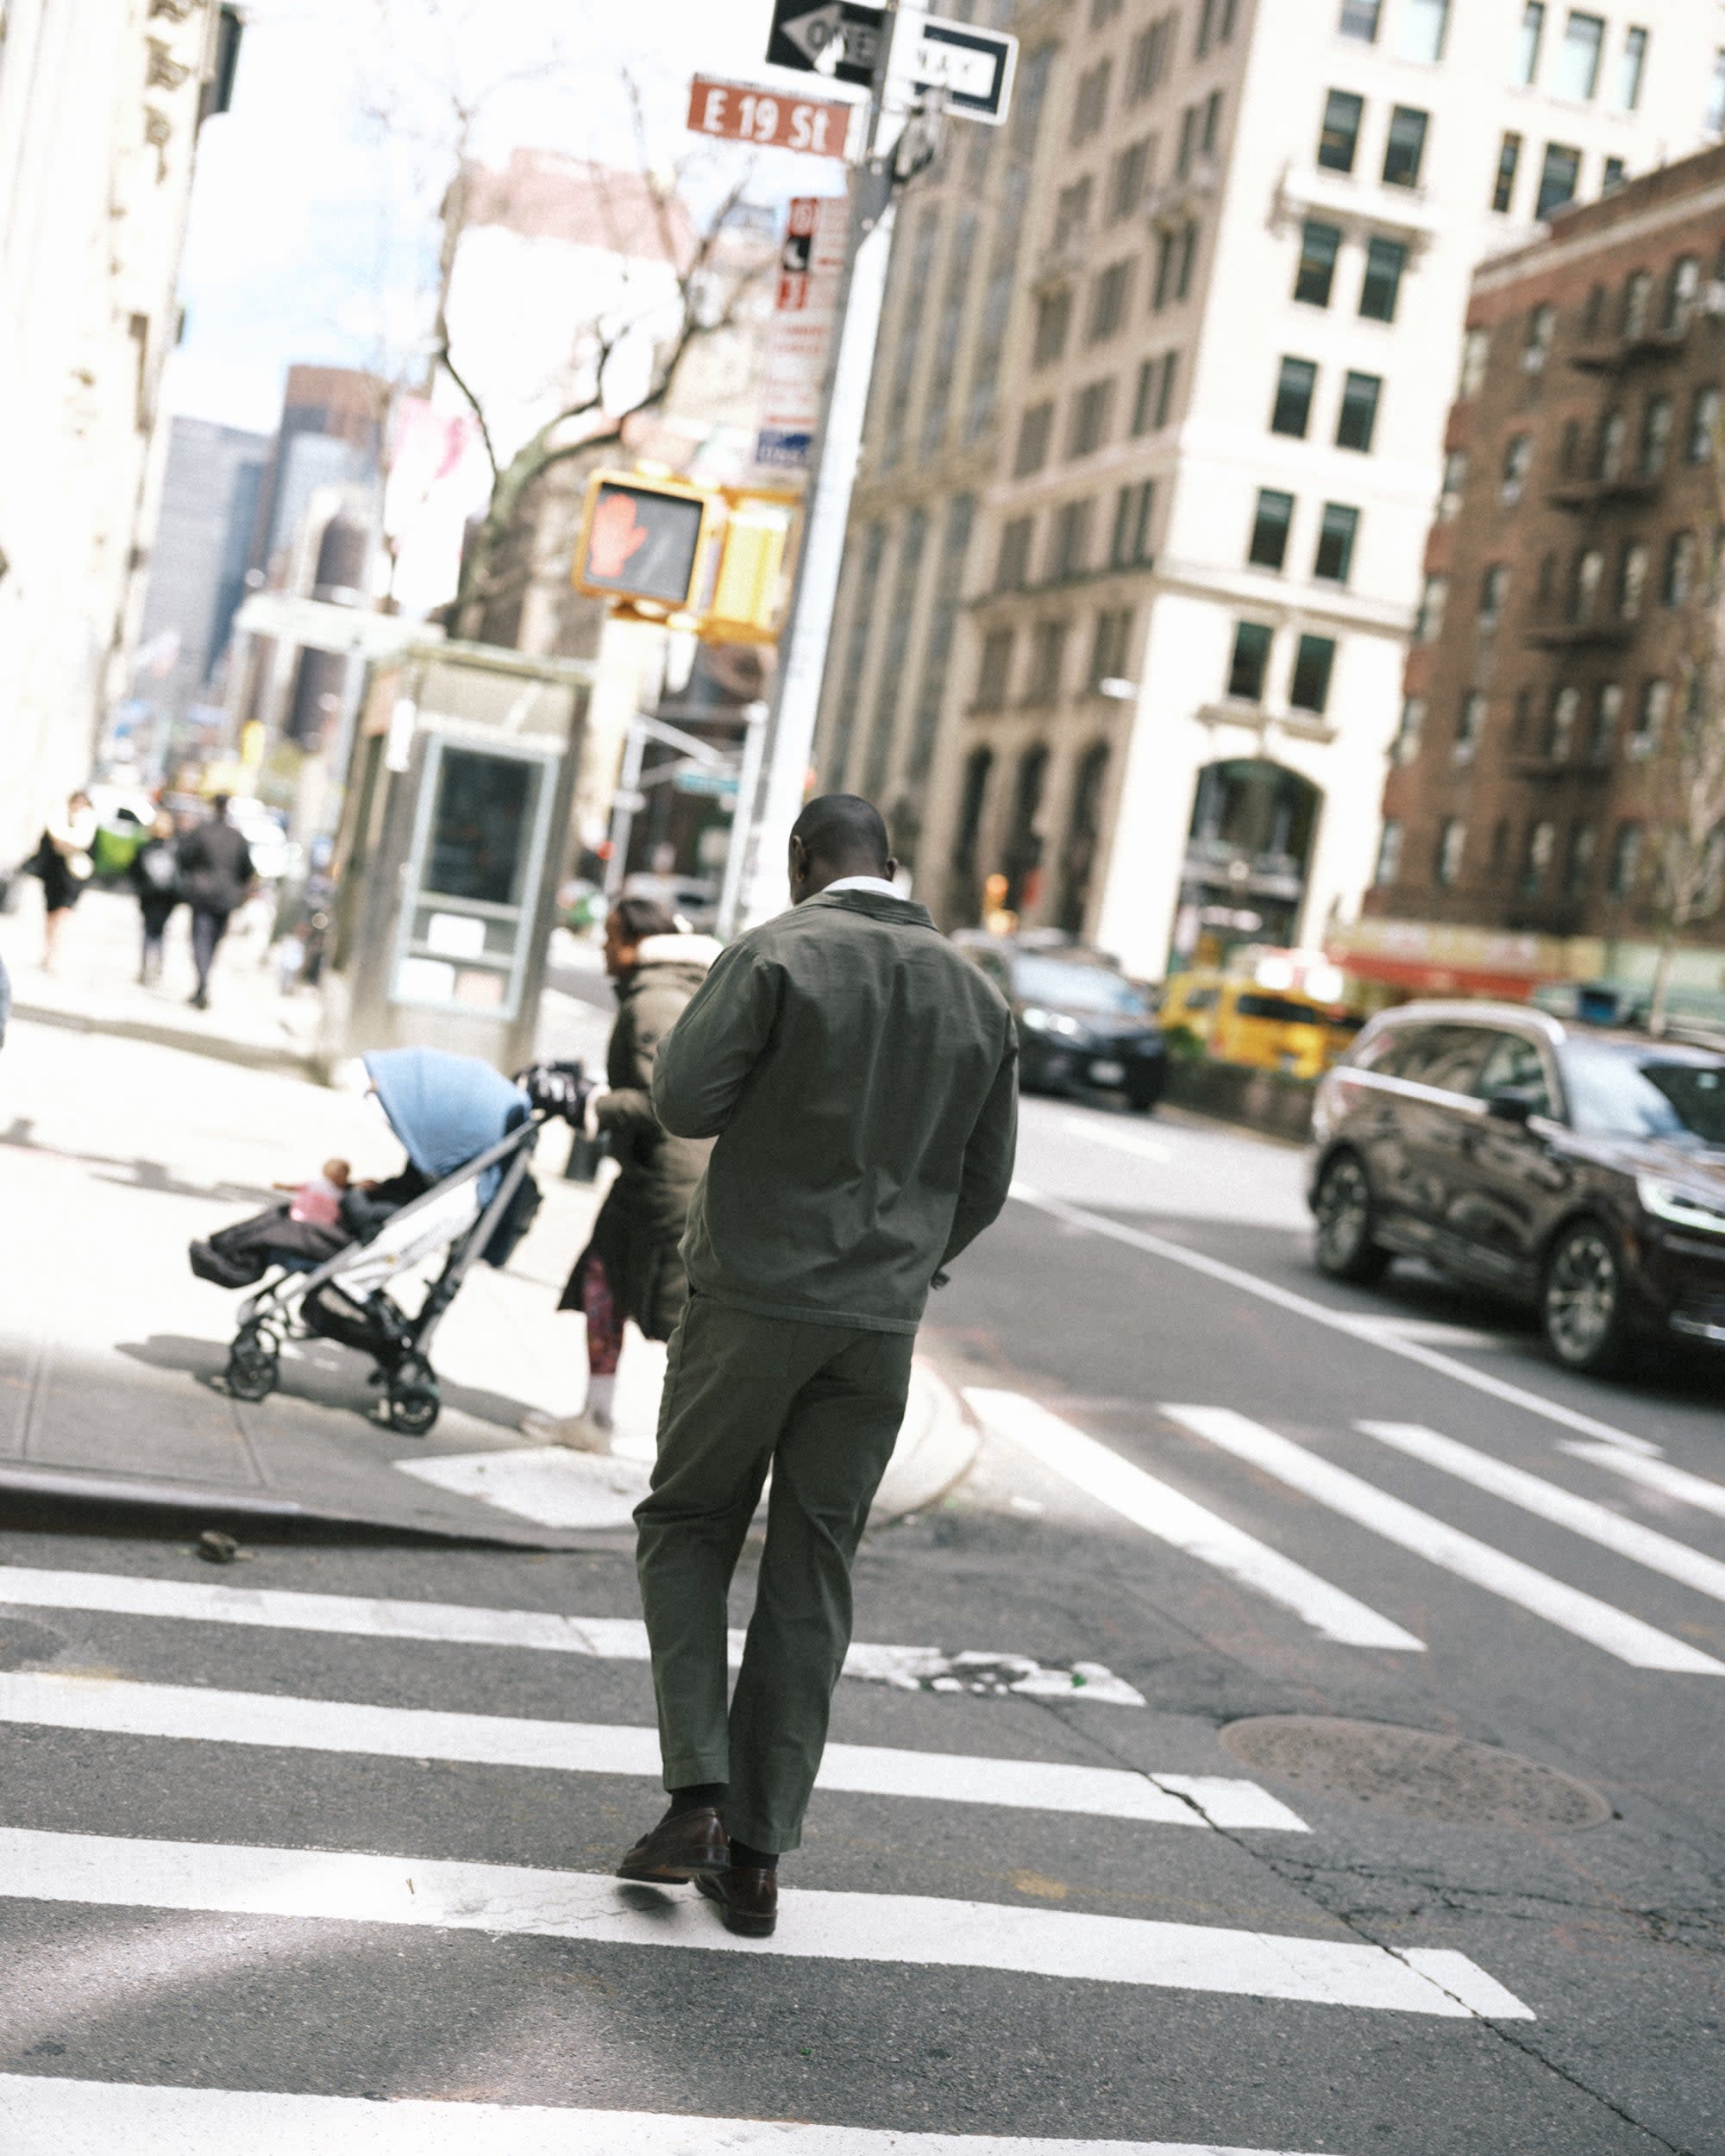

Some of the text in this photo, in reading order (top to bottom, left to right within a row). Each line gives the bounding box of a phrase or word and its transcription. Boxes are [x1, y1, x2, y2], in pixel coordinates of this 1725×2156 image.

[703, 88, 830, 153] E 19 St
